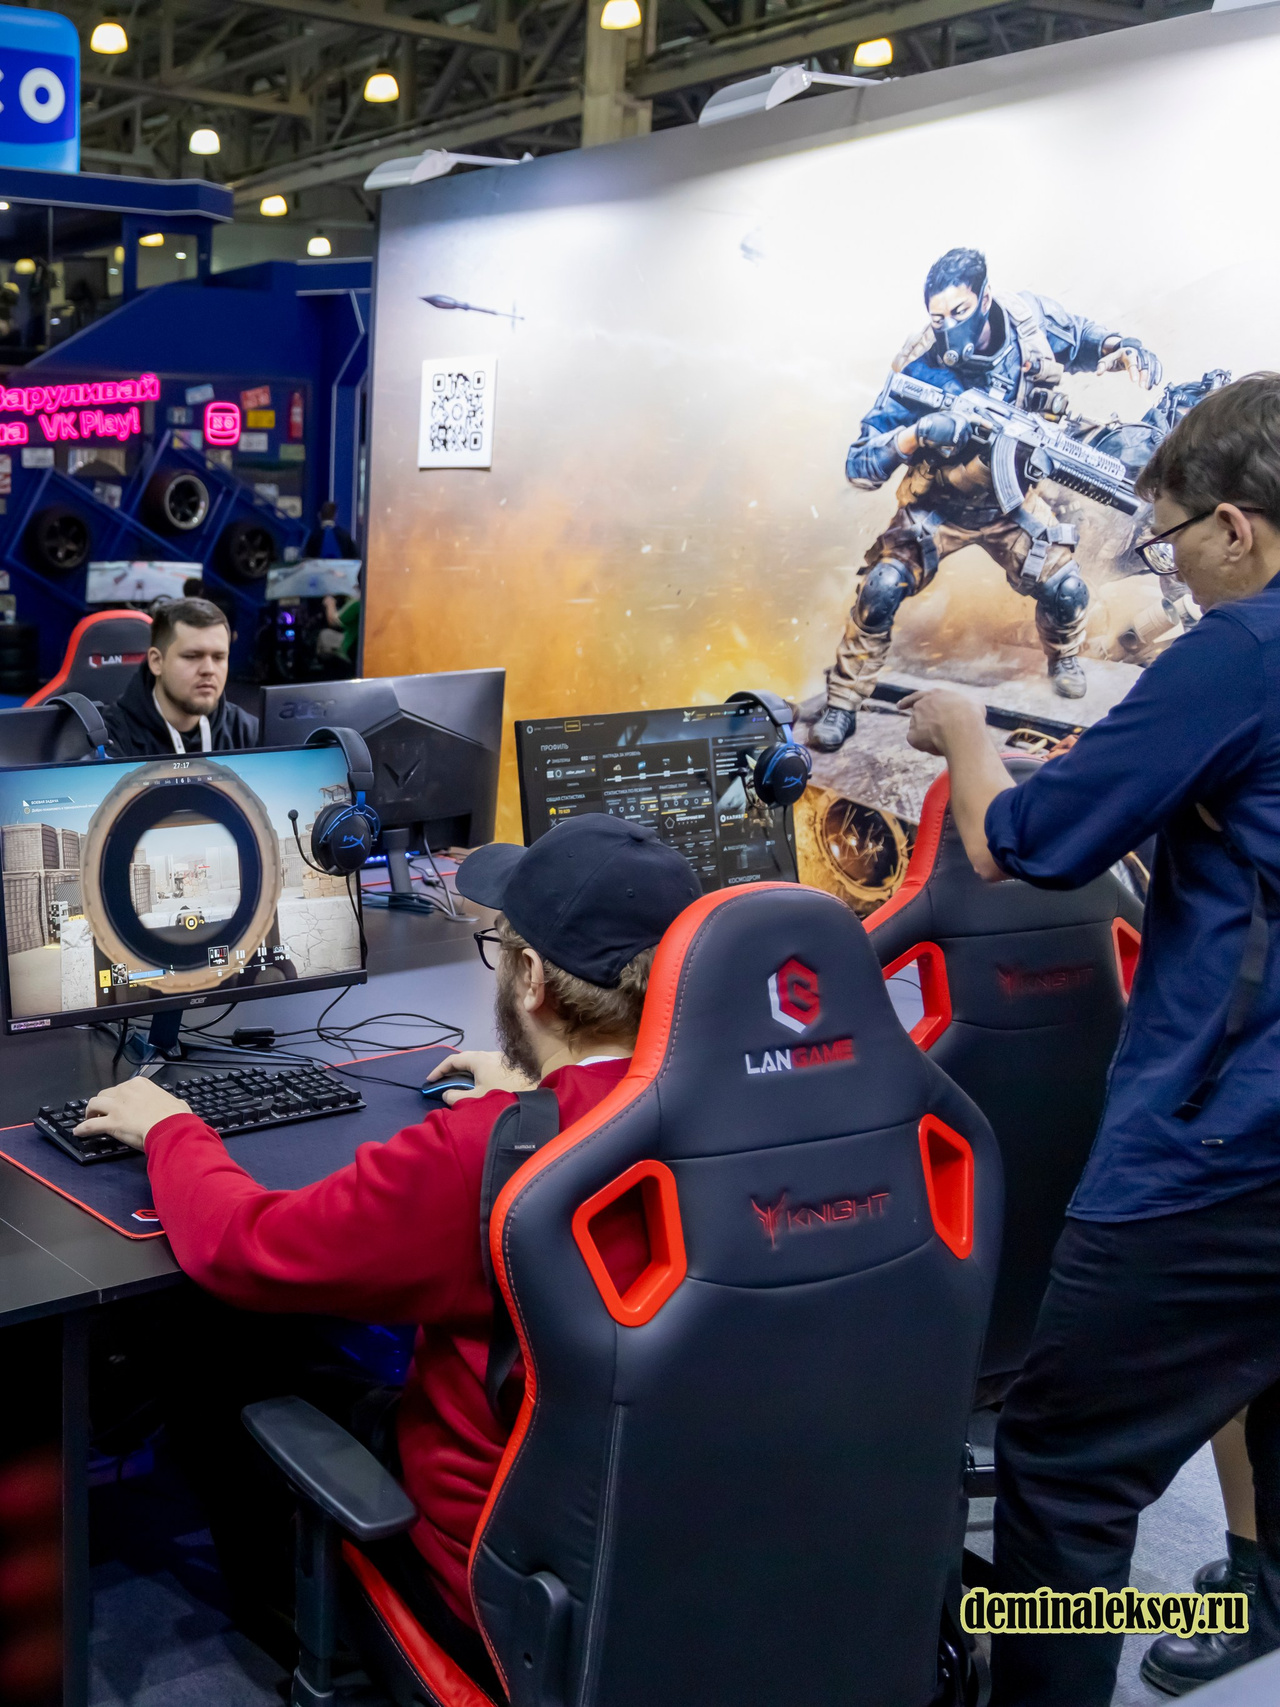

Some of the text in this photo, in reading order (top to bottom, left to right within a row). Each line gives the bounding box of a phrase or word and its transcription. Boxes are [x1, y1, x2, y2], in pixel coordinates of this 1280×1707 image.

[38, 411, 79, 442] VK
[79, 406, 141, 442] Play!
[173, 762, 190, 770] 27:17
[190, 996, 208, 1005] acer
[745, 1039, 855, 1074] LANGAME
[787, 1193, 889, 1231] KNIGHT
